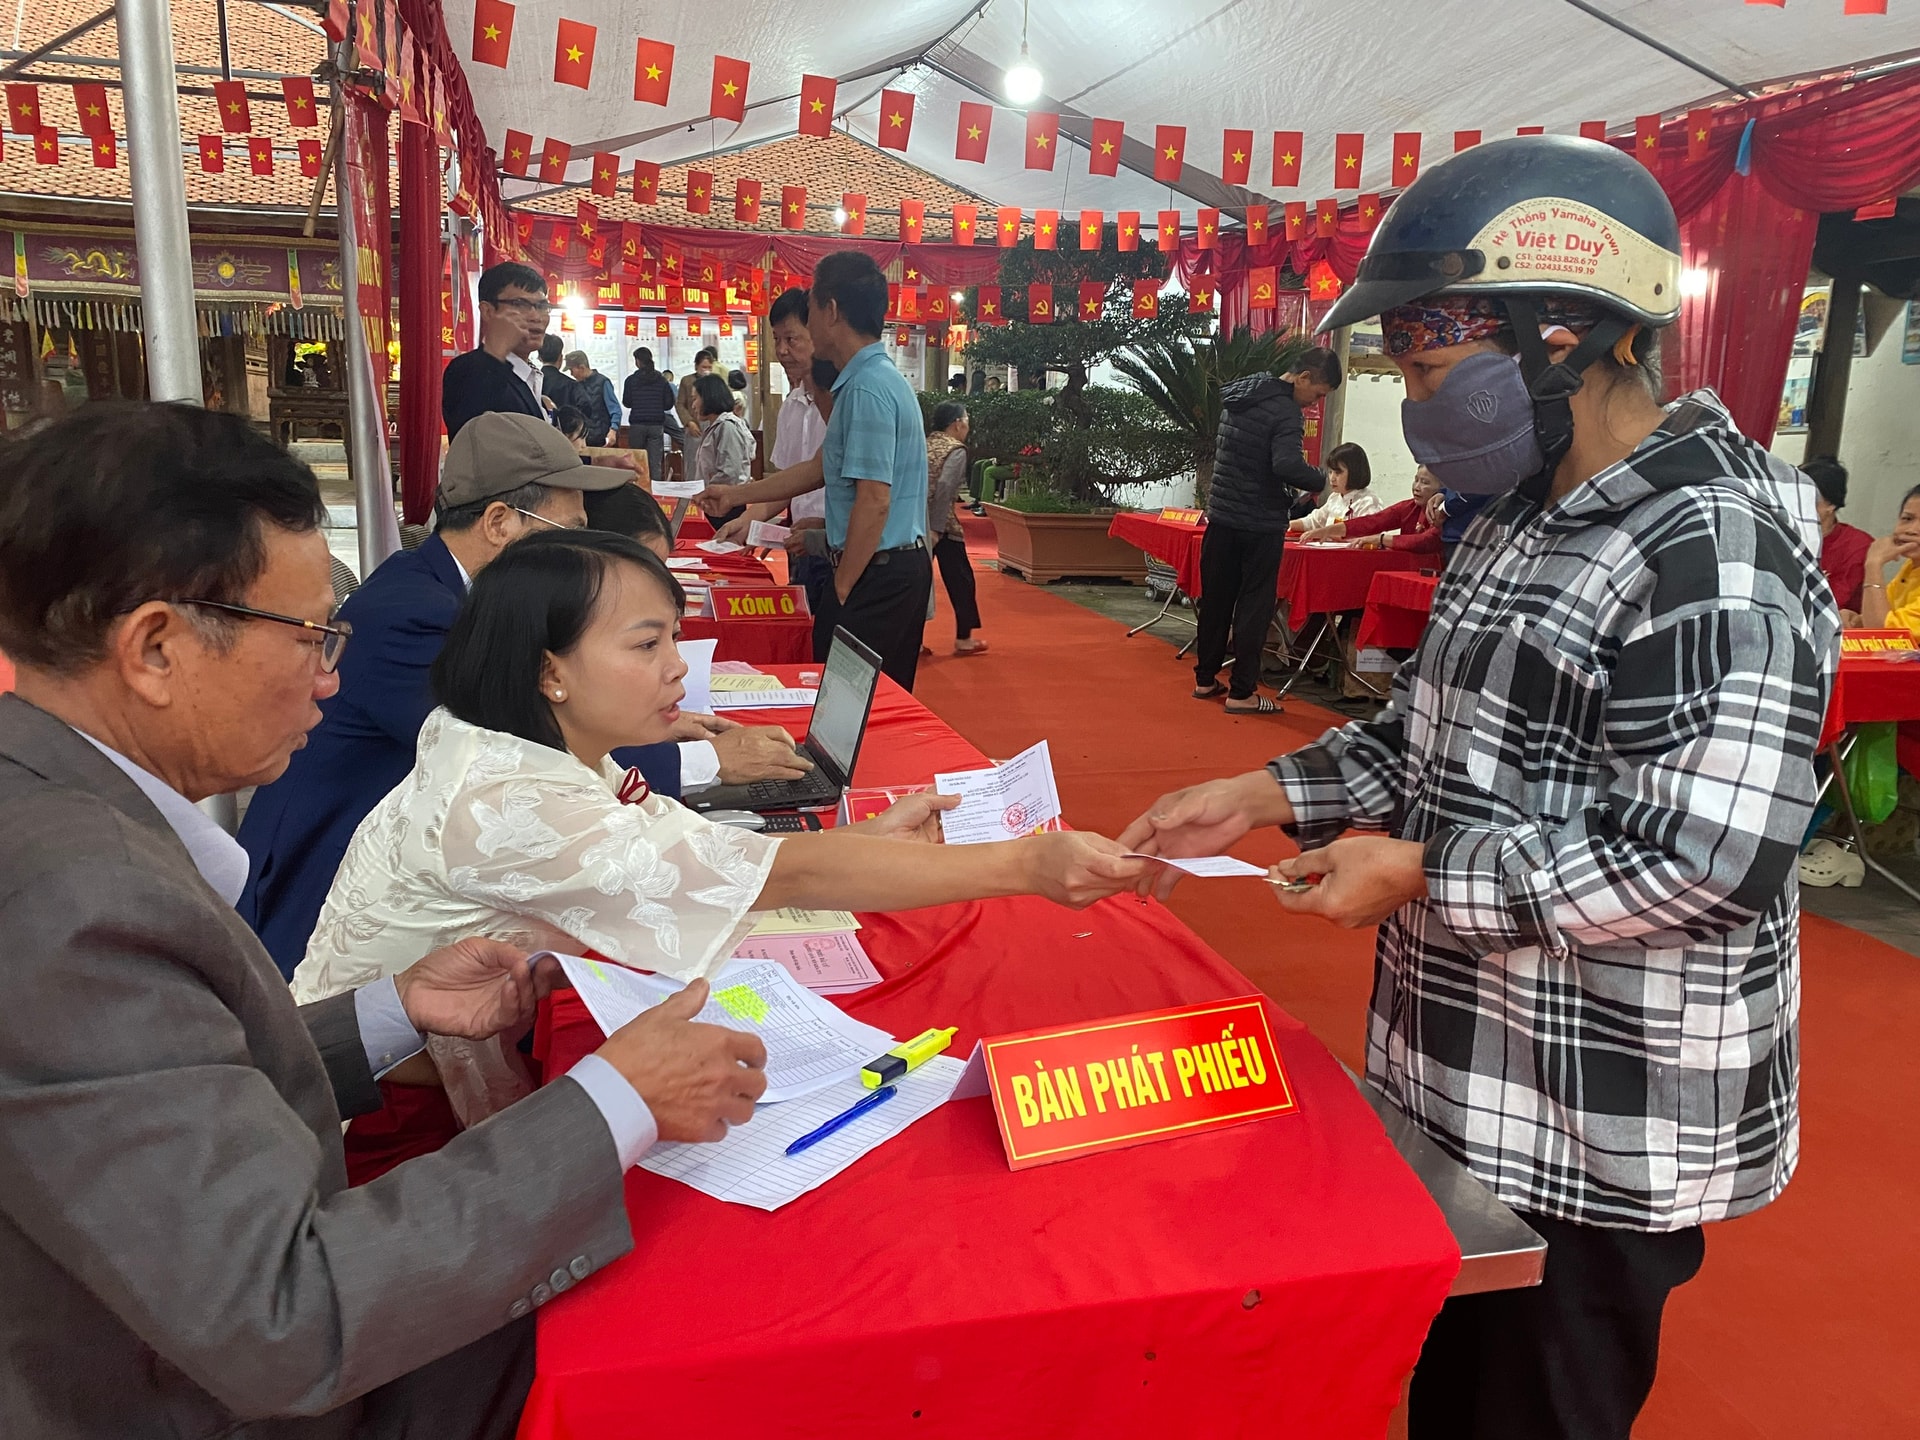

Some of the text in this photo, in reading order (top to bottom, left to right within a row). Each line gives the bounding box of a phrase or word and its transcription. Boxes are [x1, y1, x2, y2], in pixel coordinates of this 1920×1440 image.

[1551, 208, 1597, 228] Yamaha
[1600, 225, 1620, 256] Town
[1565, 234, 1605, 257] Duy
[1514, 261, 1532, 269] CS2:
[1515, 253, 1532, 261] CS1:
[727, 593, 795, 615] XÓM Ô
[1011, 1023, 1267, 1128] BÀN PHÁT PHIẾU
